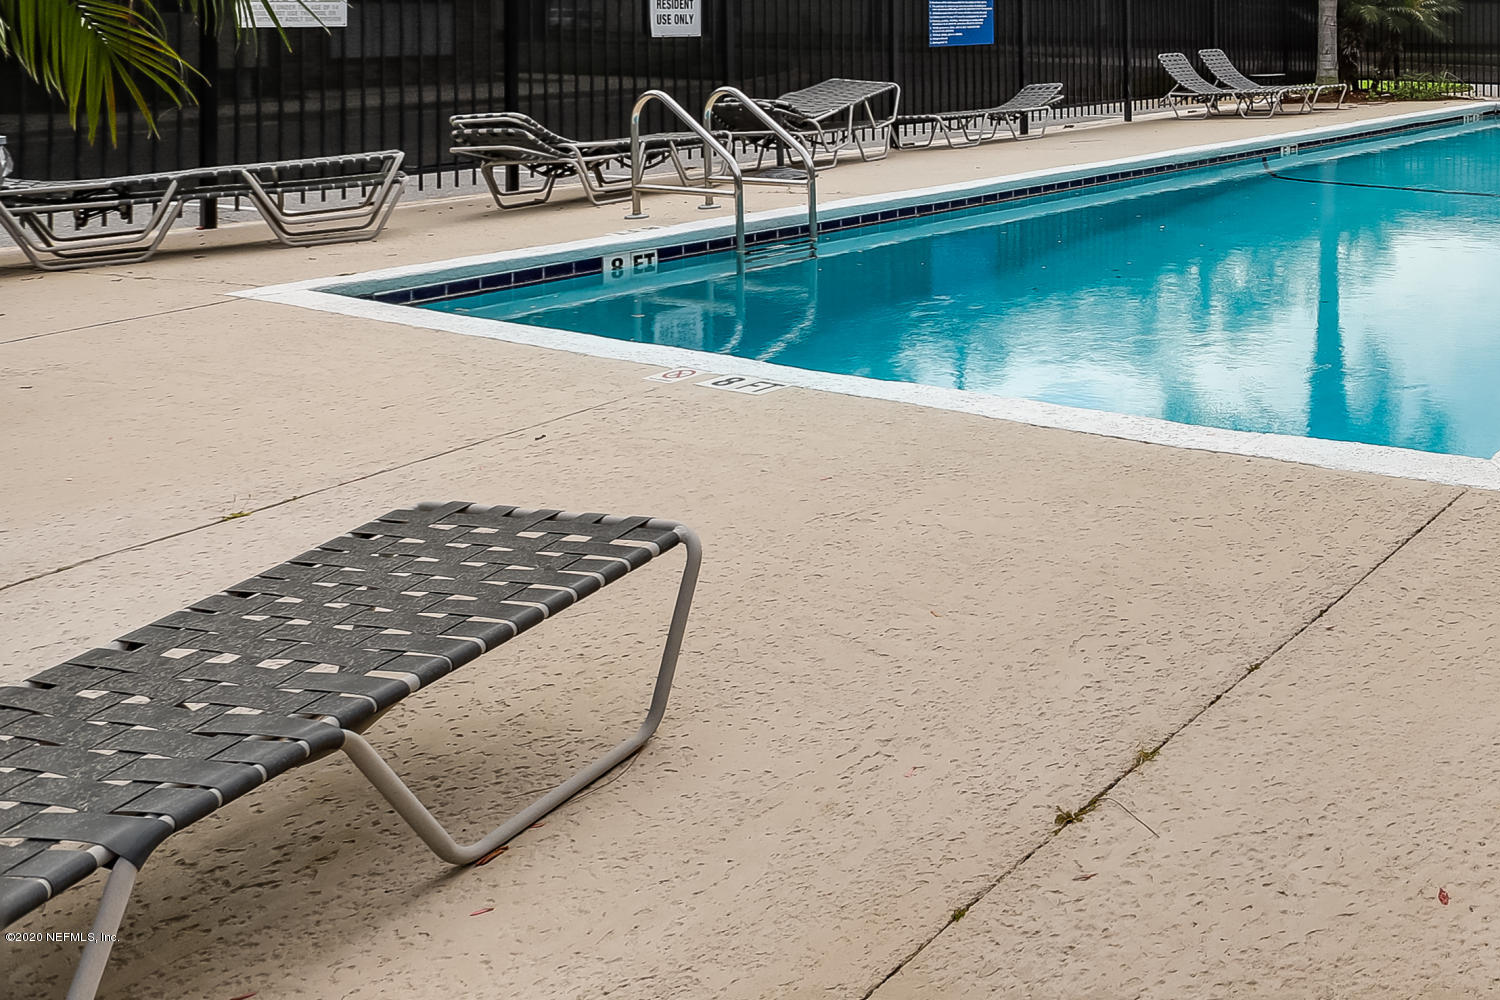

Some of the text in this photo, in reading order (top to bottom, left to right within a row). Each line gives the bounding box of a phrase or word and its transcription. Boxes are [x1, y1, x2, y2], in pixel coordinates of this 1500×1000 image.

[656, 13, 694, 25] USE ONLY
[633, 252, 656, 269] FT
[712, 377, 785, 393] 8 FT
